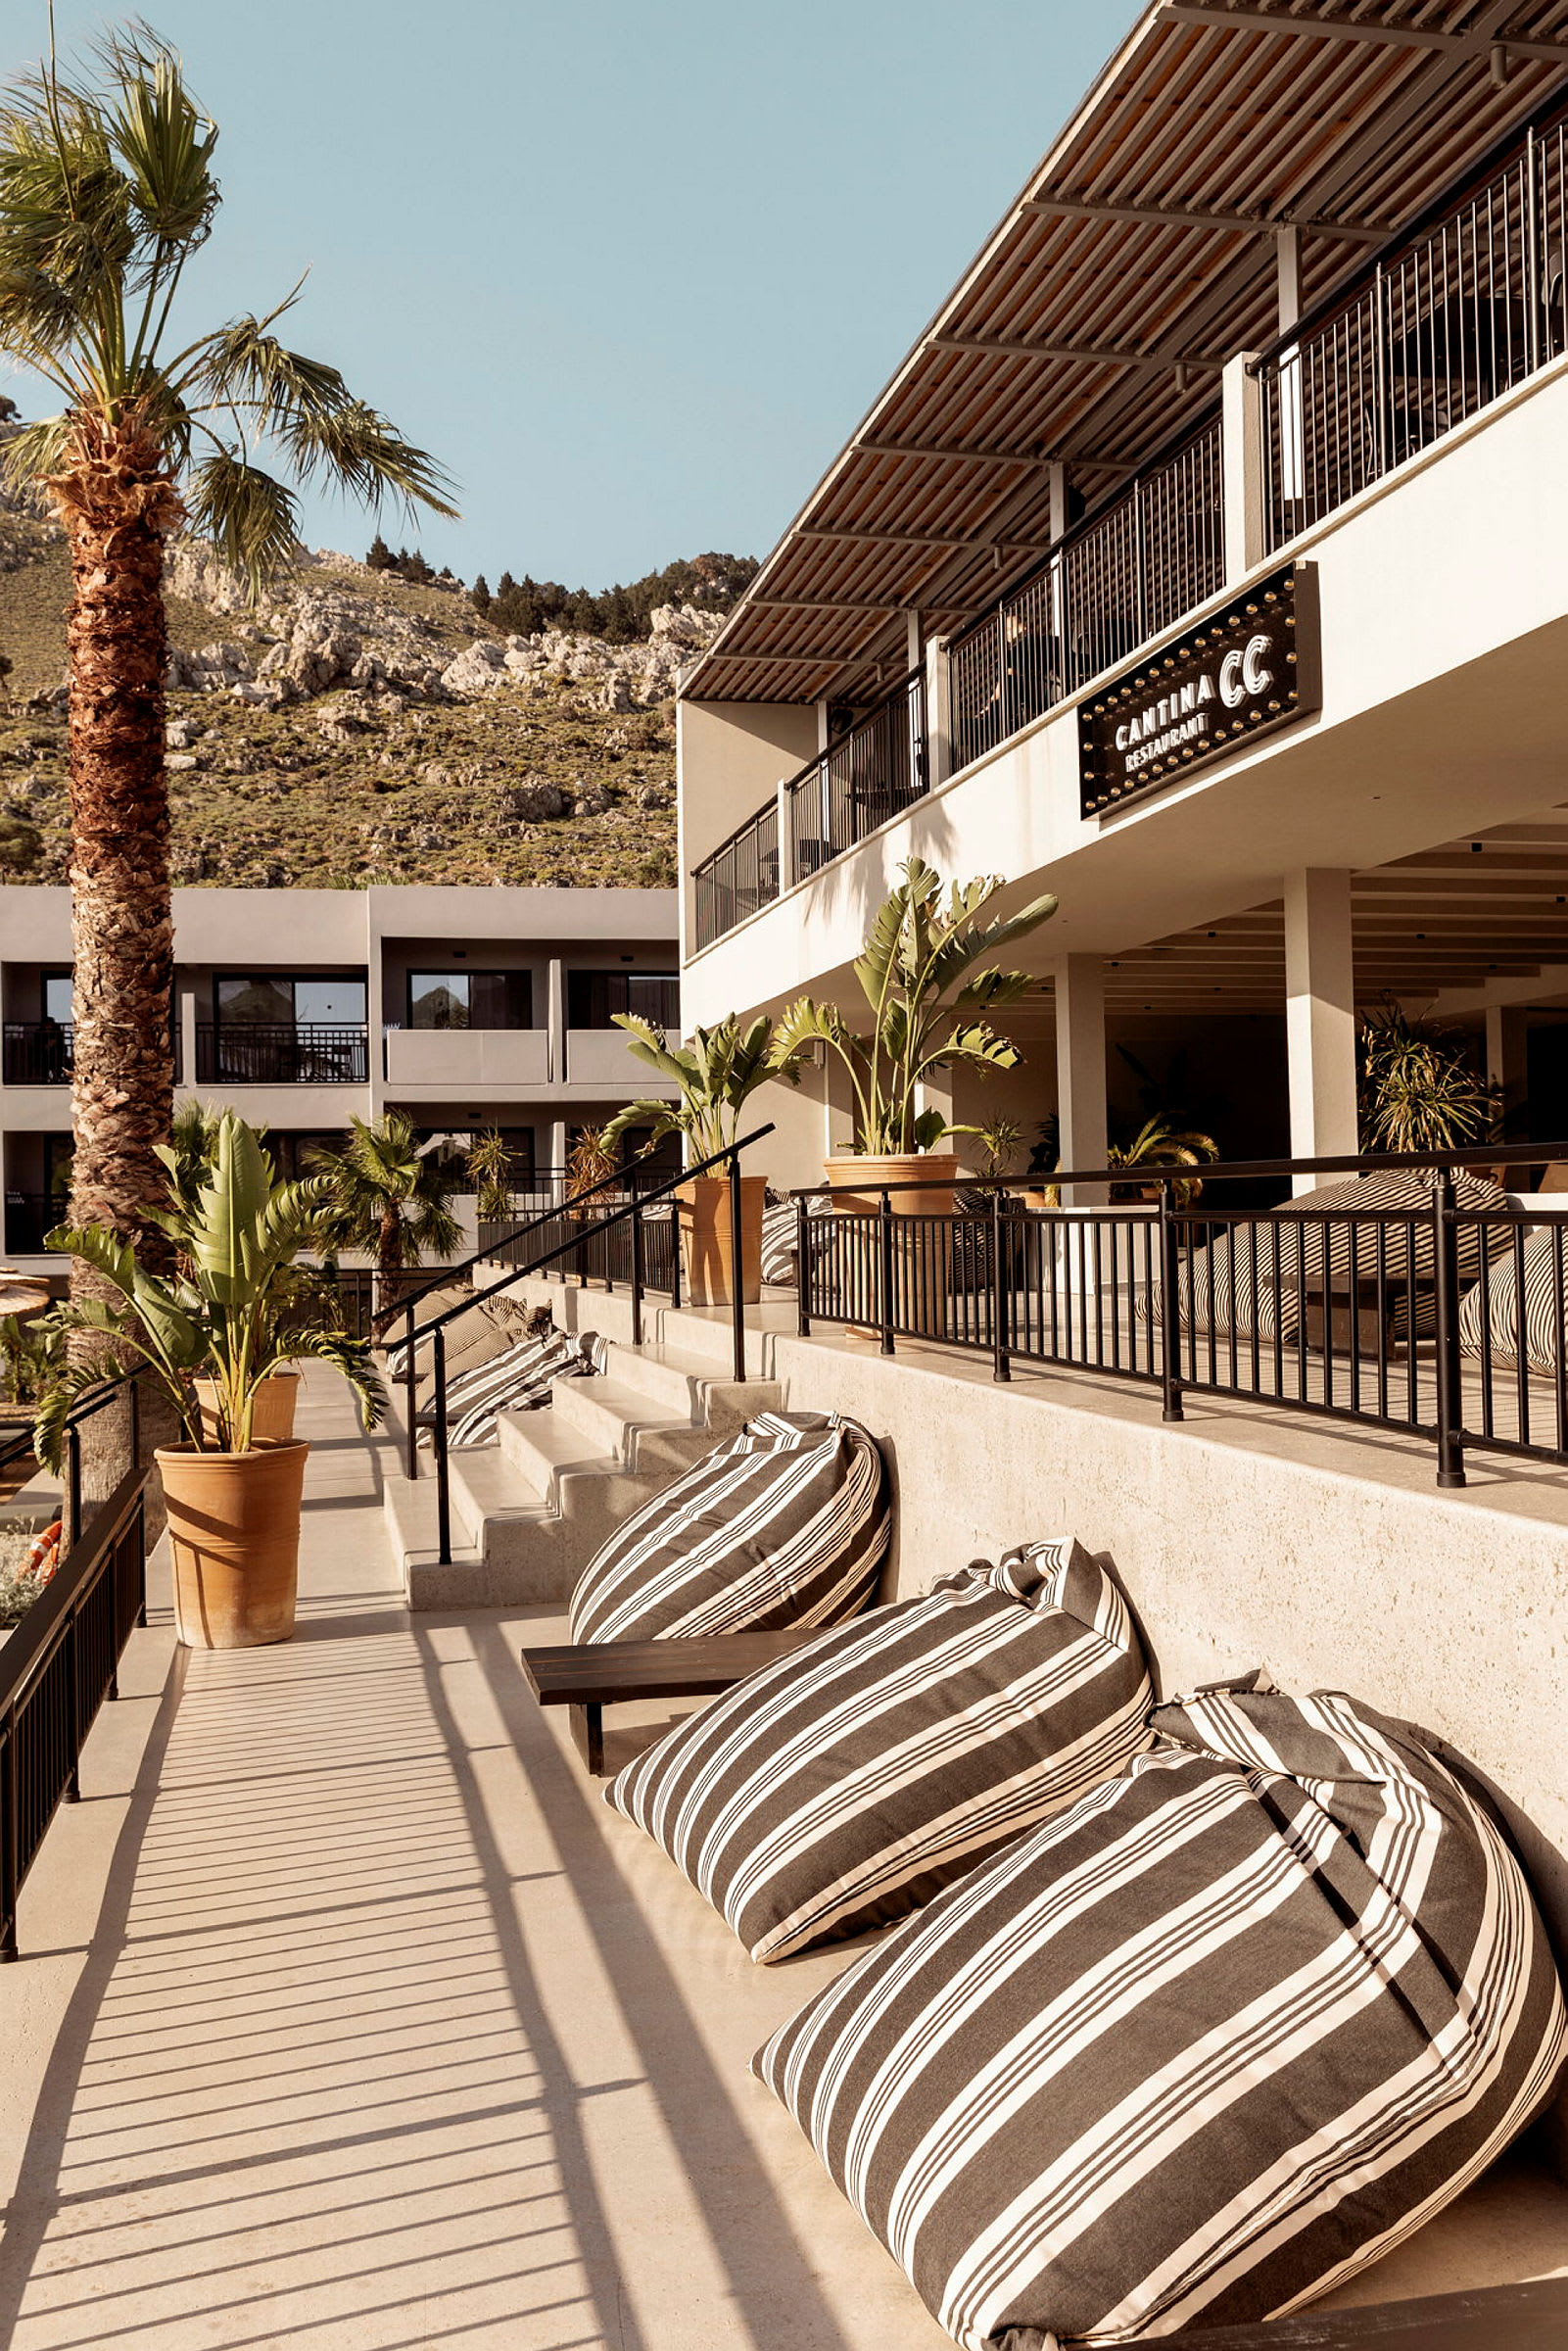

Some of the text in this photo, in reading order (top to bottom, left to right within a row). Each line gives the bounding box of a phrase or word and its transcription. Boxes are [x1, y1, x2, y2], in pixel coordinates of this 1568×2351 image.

[1116, 635, 1272, 750] CANTINA CC
[1125, 713, 1209, 772] RESTAURANT
